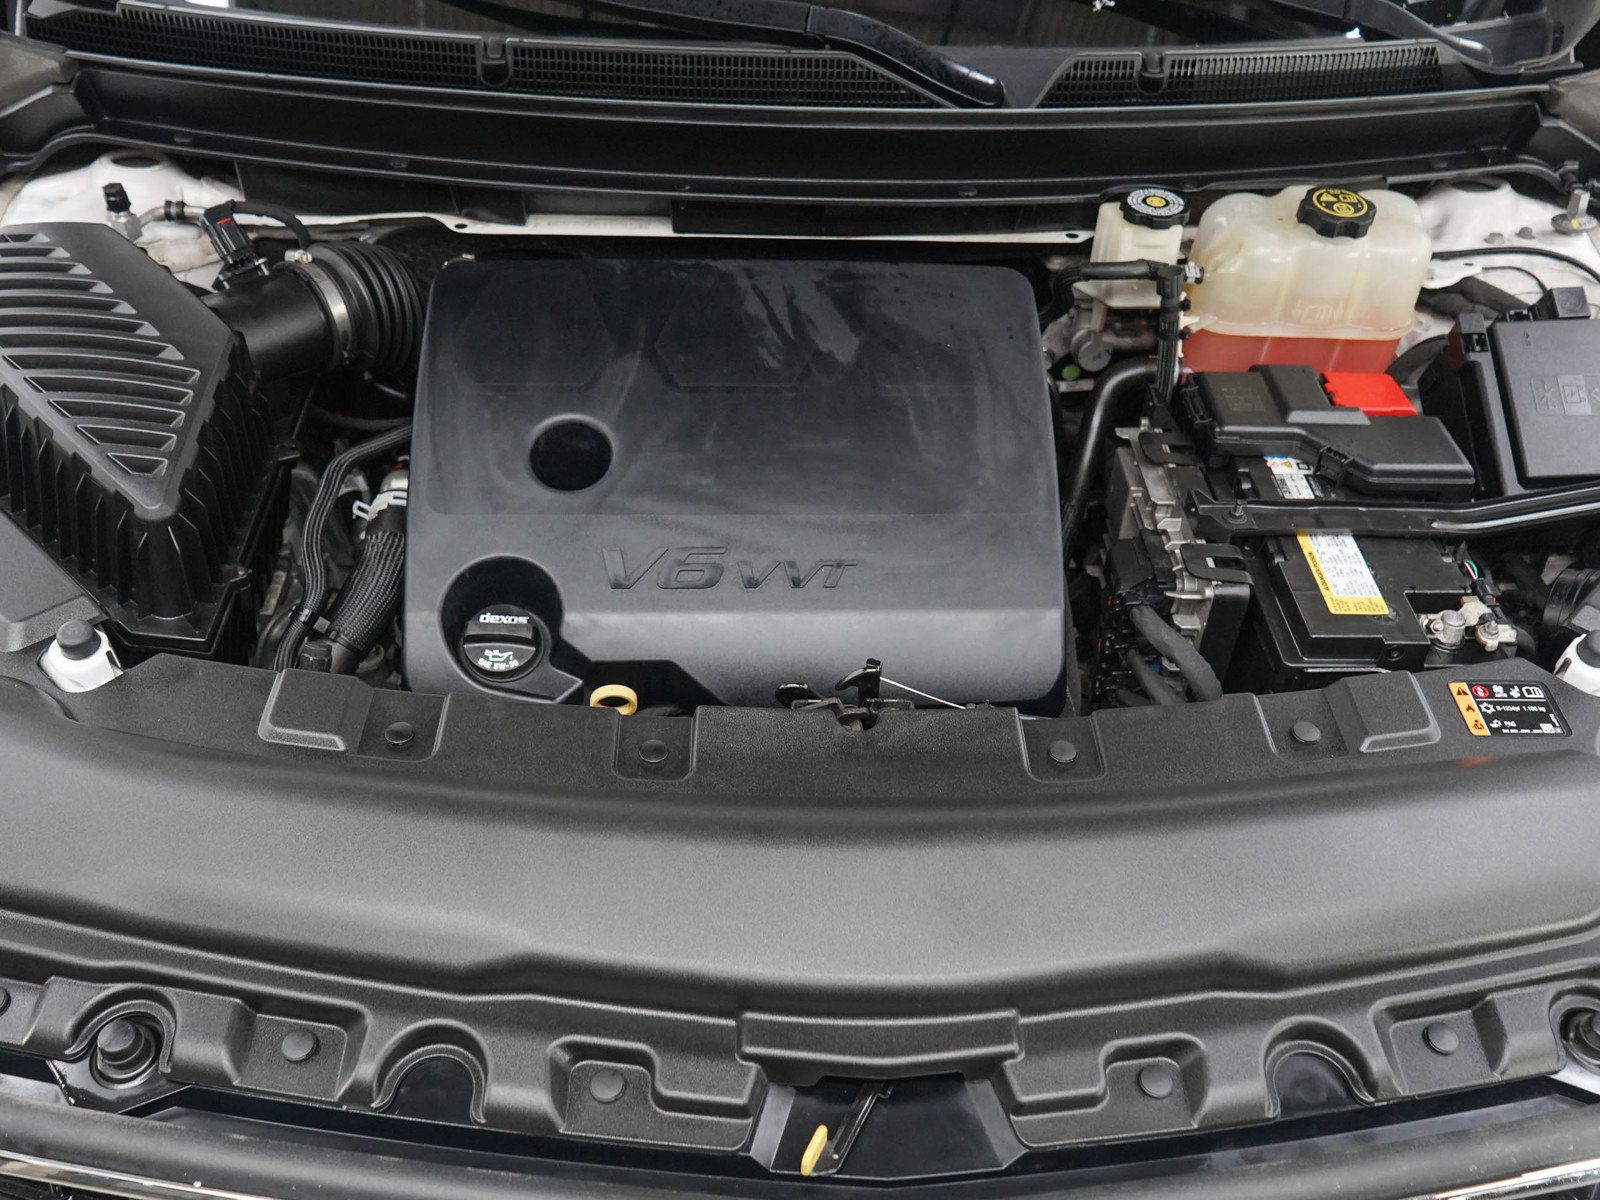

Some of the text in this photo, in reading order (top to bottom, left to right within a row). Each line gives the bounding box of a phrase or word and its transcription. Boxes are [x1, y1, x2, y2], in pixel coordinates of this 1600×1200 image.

[602, 546, 858, 589] V6 VVT
[479, 612, 529, 624] dexos
[477, 657, 519, 670] SAE 5W-30
